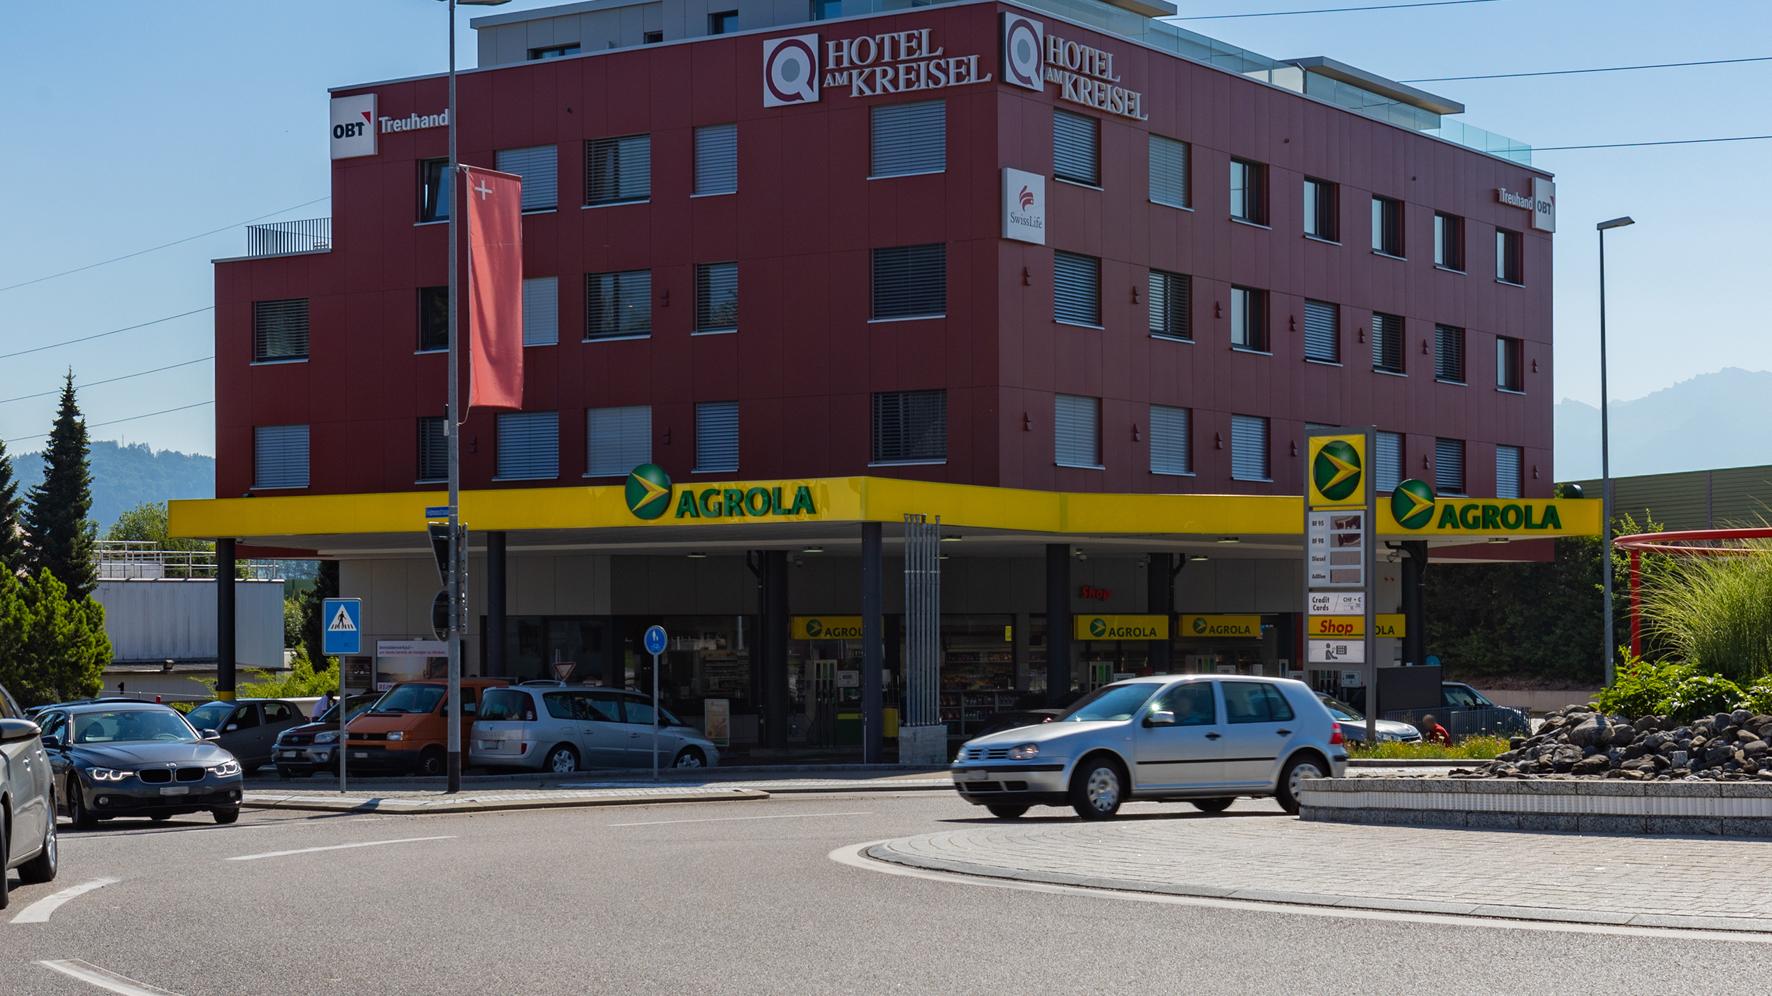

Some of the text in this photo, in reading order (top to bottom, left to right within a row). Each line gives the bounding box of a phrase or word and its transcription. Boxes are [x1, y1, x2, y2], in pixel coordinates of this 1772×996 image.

[826, 28, 943, 70] HOTEL
[1046, 34, 1121, 82] HOTEL
[823, 54, 993, 98] AM KREISEL
[1046, 67, 1149, 121] AM KREISEL
[333, 108, 449, 139] OBT Treuhand
[1499, 187, 1552, 216] Treuhand OBT
[674, 486, 816, 519] AGROLA
[1437, 504, 1562, 530] AGROLA
[1312, 596, 1330, 604] Credit
[824, 627, 864, 637] AGROL
[1108, 627, 1157, 638] AGROLA
[1208, 625, 1251, 635] AGROLA
[1320, 619, 1354, 636] Shop
